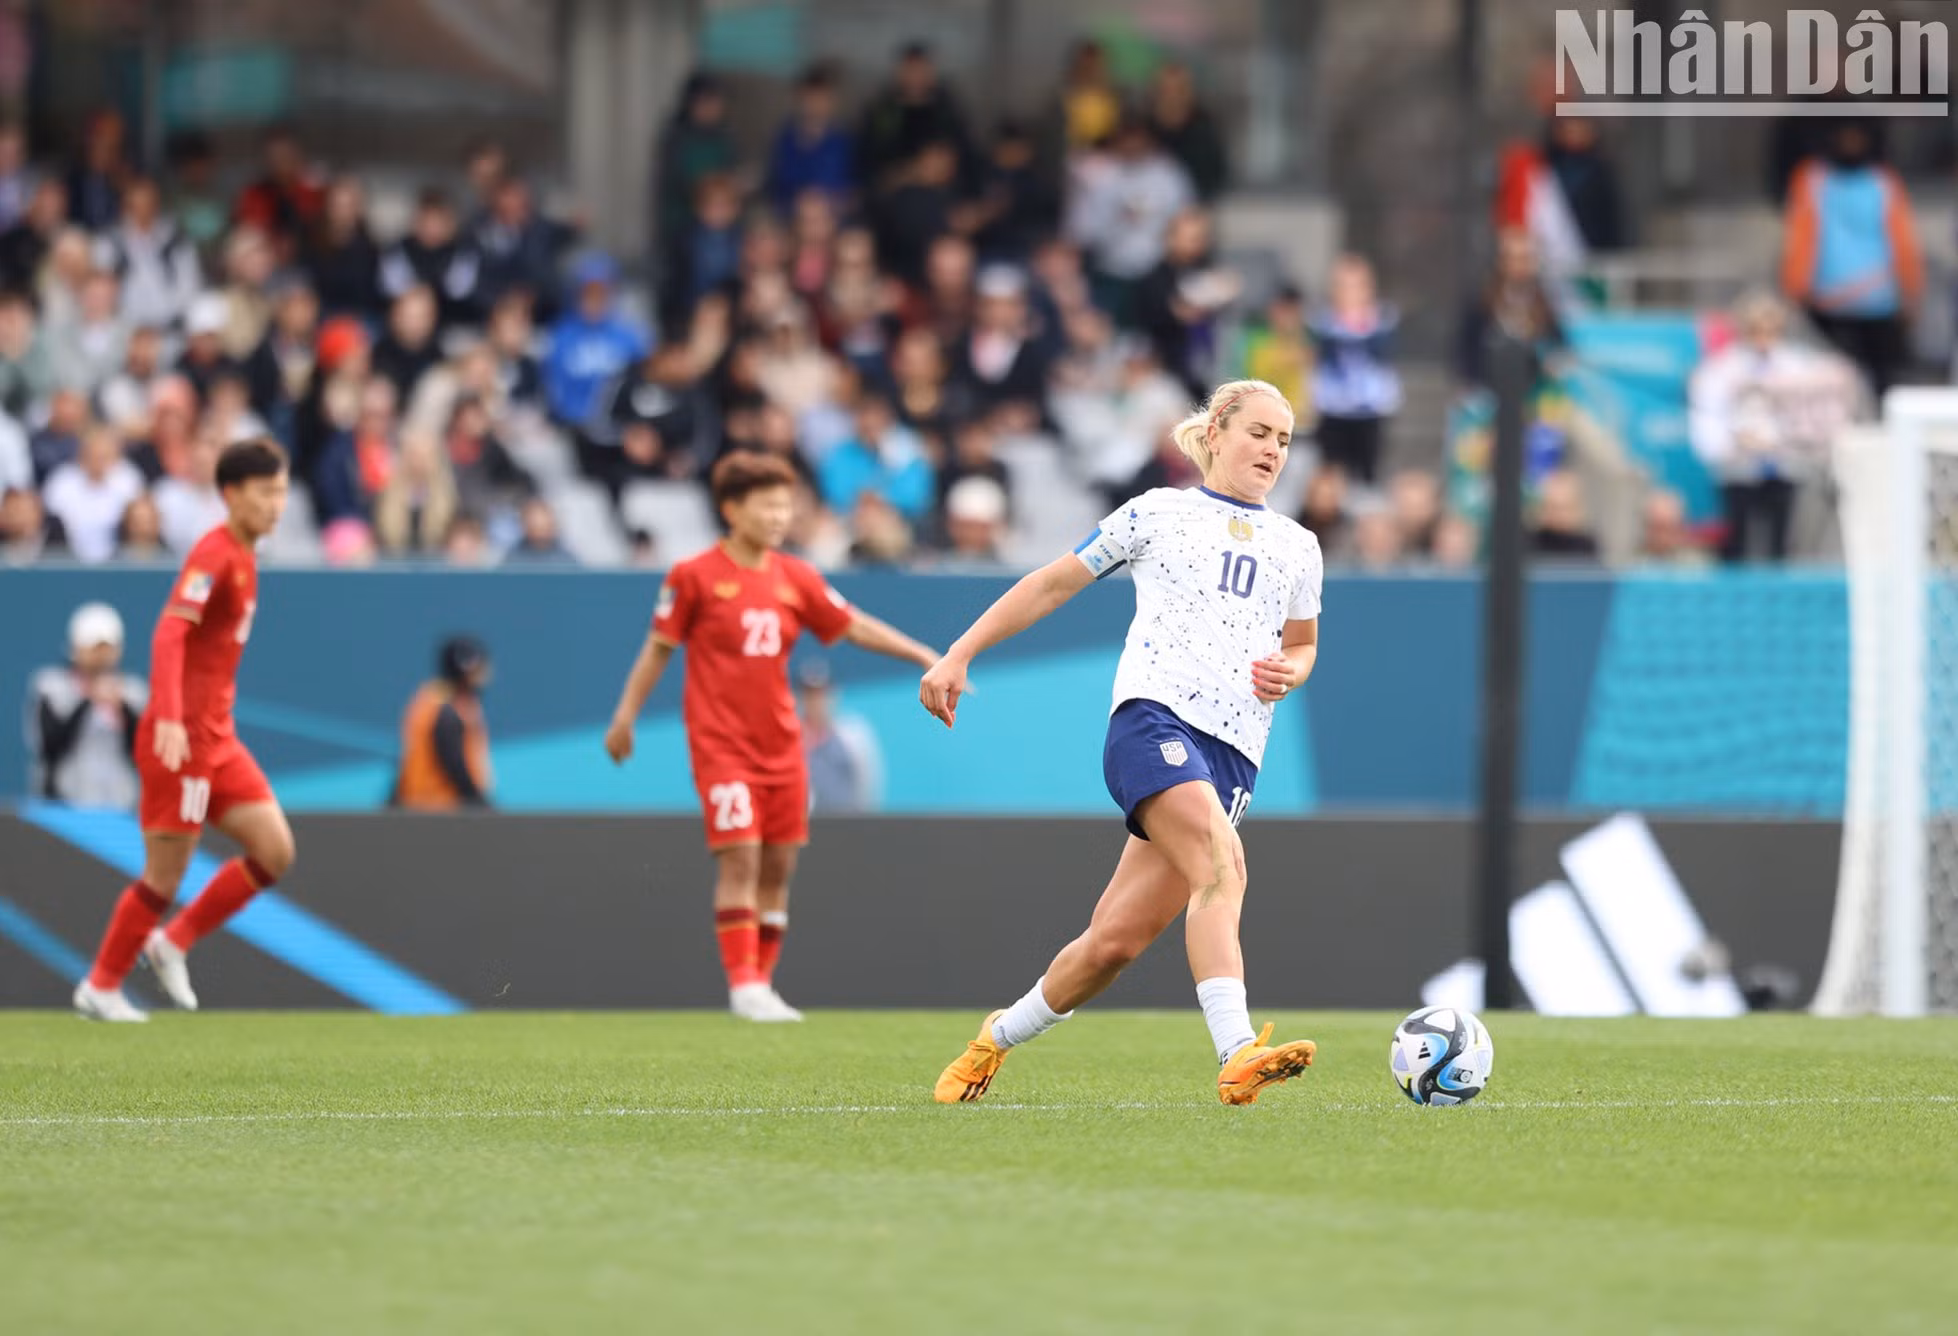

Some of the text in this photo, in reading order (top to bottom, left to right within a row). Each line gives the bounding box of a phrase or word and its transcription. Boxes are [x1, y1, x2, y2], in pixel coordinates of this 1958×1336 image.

[1217, 550, 1258, 599] 10
[740, 608, 782, 657] 23
[1161, 742, 1182, 752] USA
[180, 776, 211, 825] 10
[709, 780, 753, 831] 23
